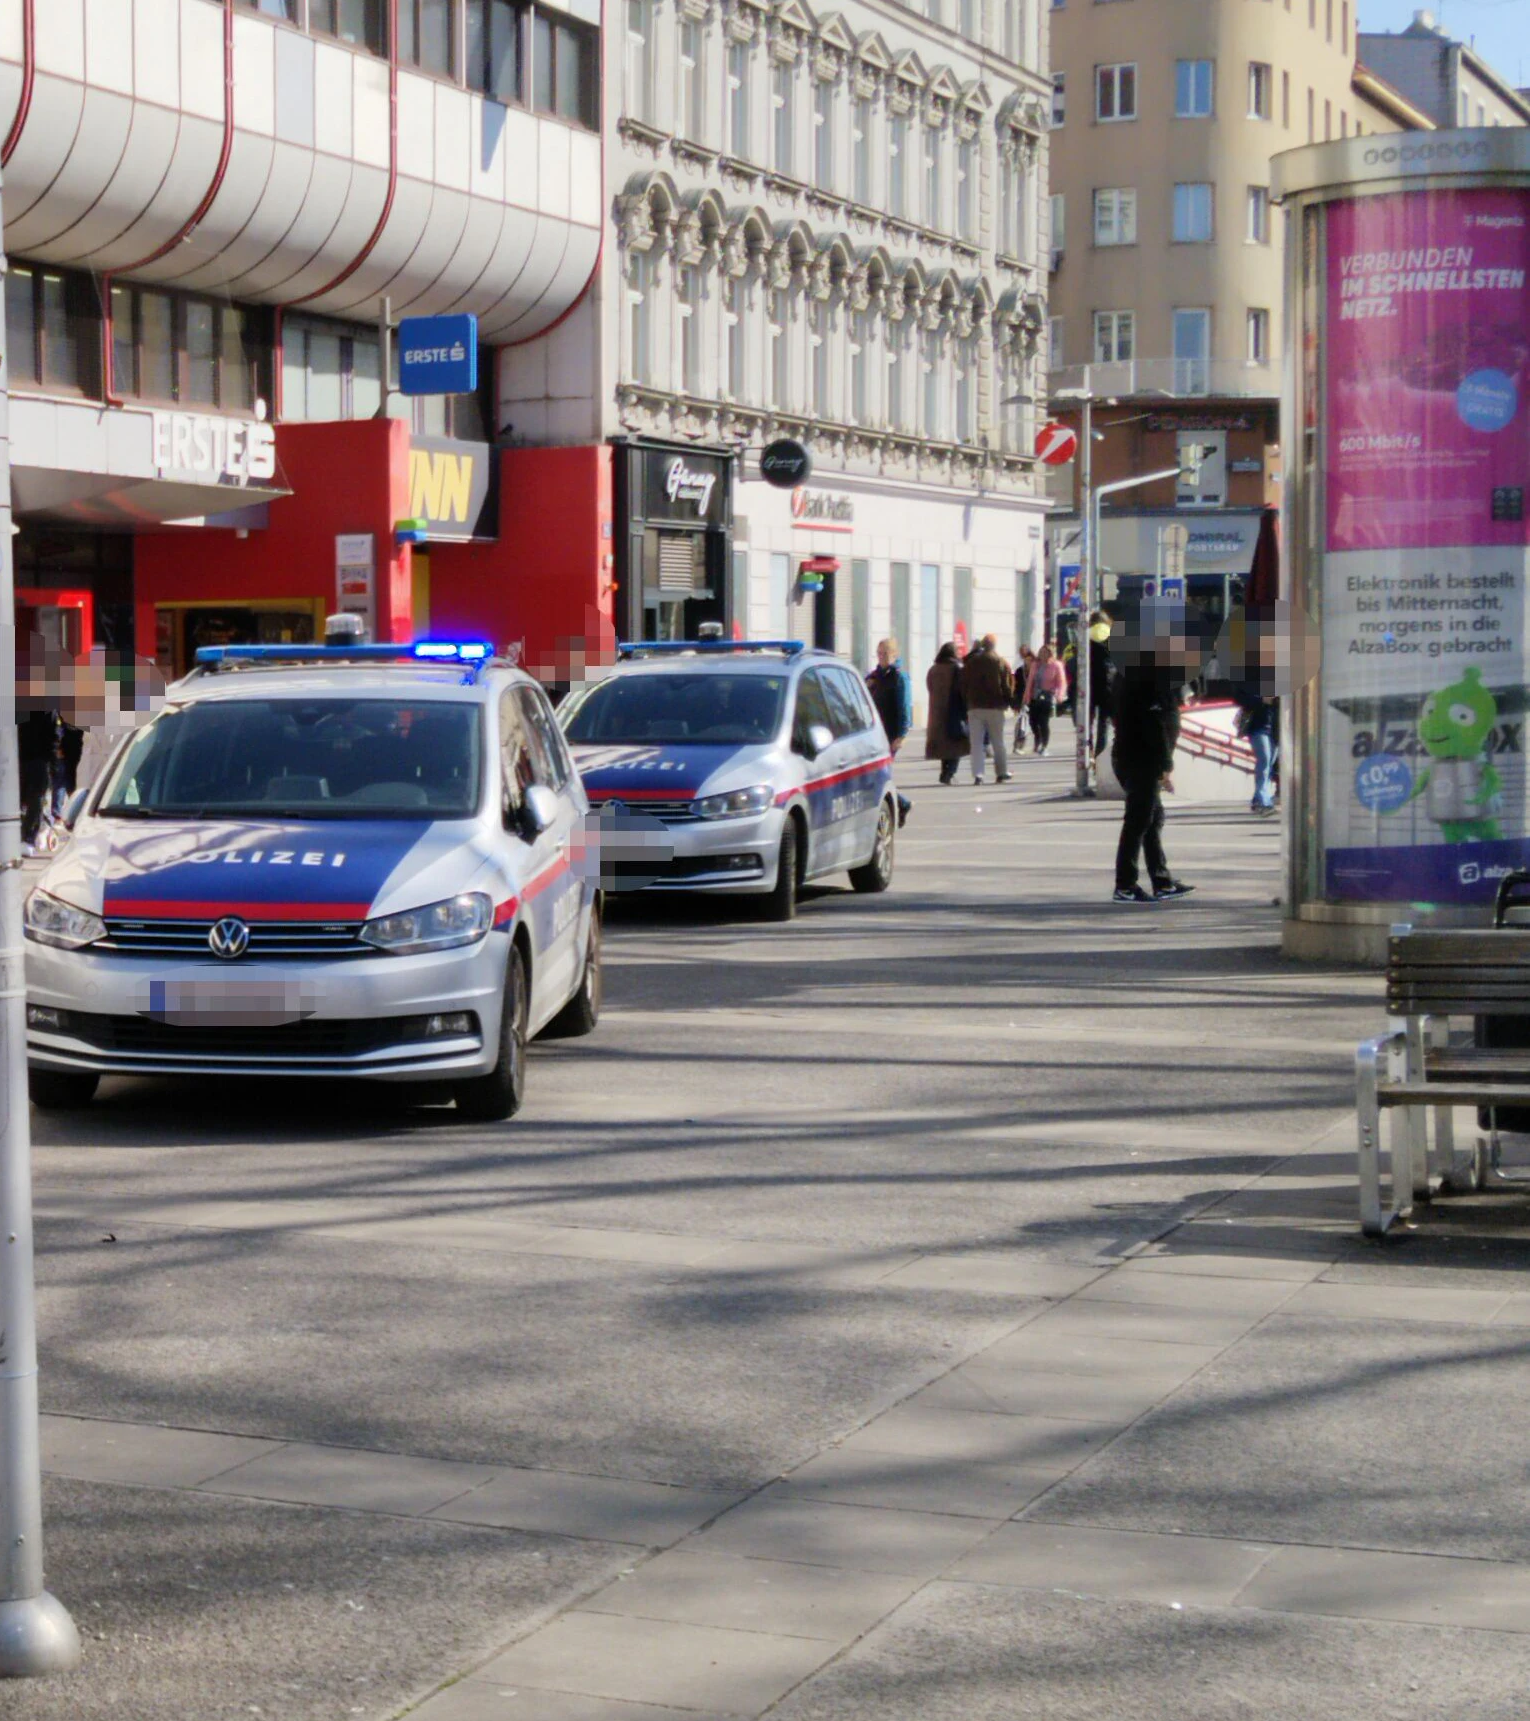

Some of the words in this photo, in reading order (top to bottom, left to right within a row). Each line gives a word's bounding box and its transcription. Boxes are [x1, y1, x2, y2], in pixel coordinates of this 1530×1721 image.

[1340, 248, 1473, 275] VERBUNDEN
[1342, 277, 1366, 298] IM
[1369, 268, 1525, 294] SCHNELLSTEN
[1340, 297, 1398, 320] NETZ.
[405, 348, 447, 364] ERSTE
[153, 411, 244, 475] ERSTE
[1339, 437, 1365, 452] 600
[1369, 432, 1421, 449] Mbit/s
[409, 449, 473, 522] NN
[1188, 543, 1239, 552] PORTSBAR
[1189, 532, 1244, 542] DMIRAL
[1346, 573, 1440, 591] Elektronik
[1447, 571, 1515, 589] bestellt
[1356, 597, 1381, 612] bis
[1387, 593, 1503, 611] Mitternacht,
[1359, 618, 1443, 637] morgens
[1449, 616, 1467, 631] in
[1472, 615, 1501, 631] die
[1348, 638, 1423, 654] AlzaBox
[1428, 636, 1512, 657] gebracht
